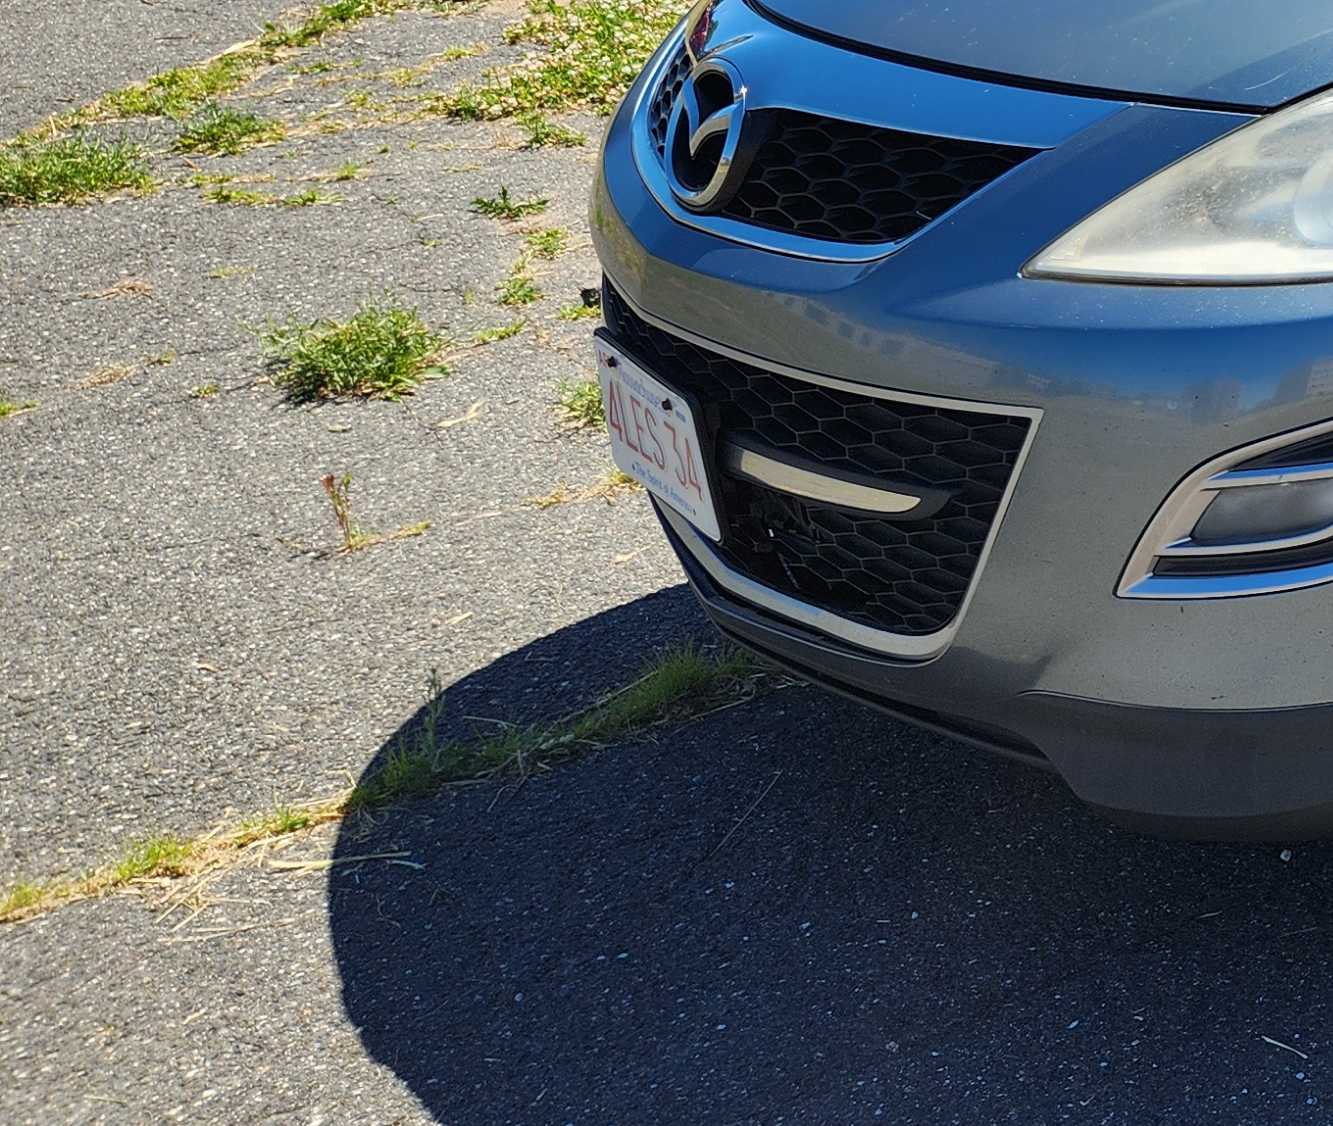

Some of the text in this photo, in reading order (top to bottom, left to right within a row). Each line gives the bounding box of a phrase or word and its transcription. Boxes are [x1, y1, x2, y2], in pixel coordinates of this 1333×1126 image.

[609, 380, 704, 502] 4LES 34
[634, 461, 647, 478] The
[647, 469, 663, 490] Spirit
[670, 487, 694, 514] America
